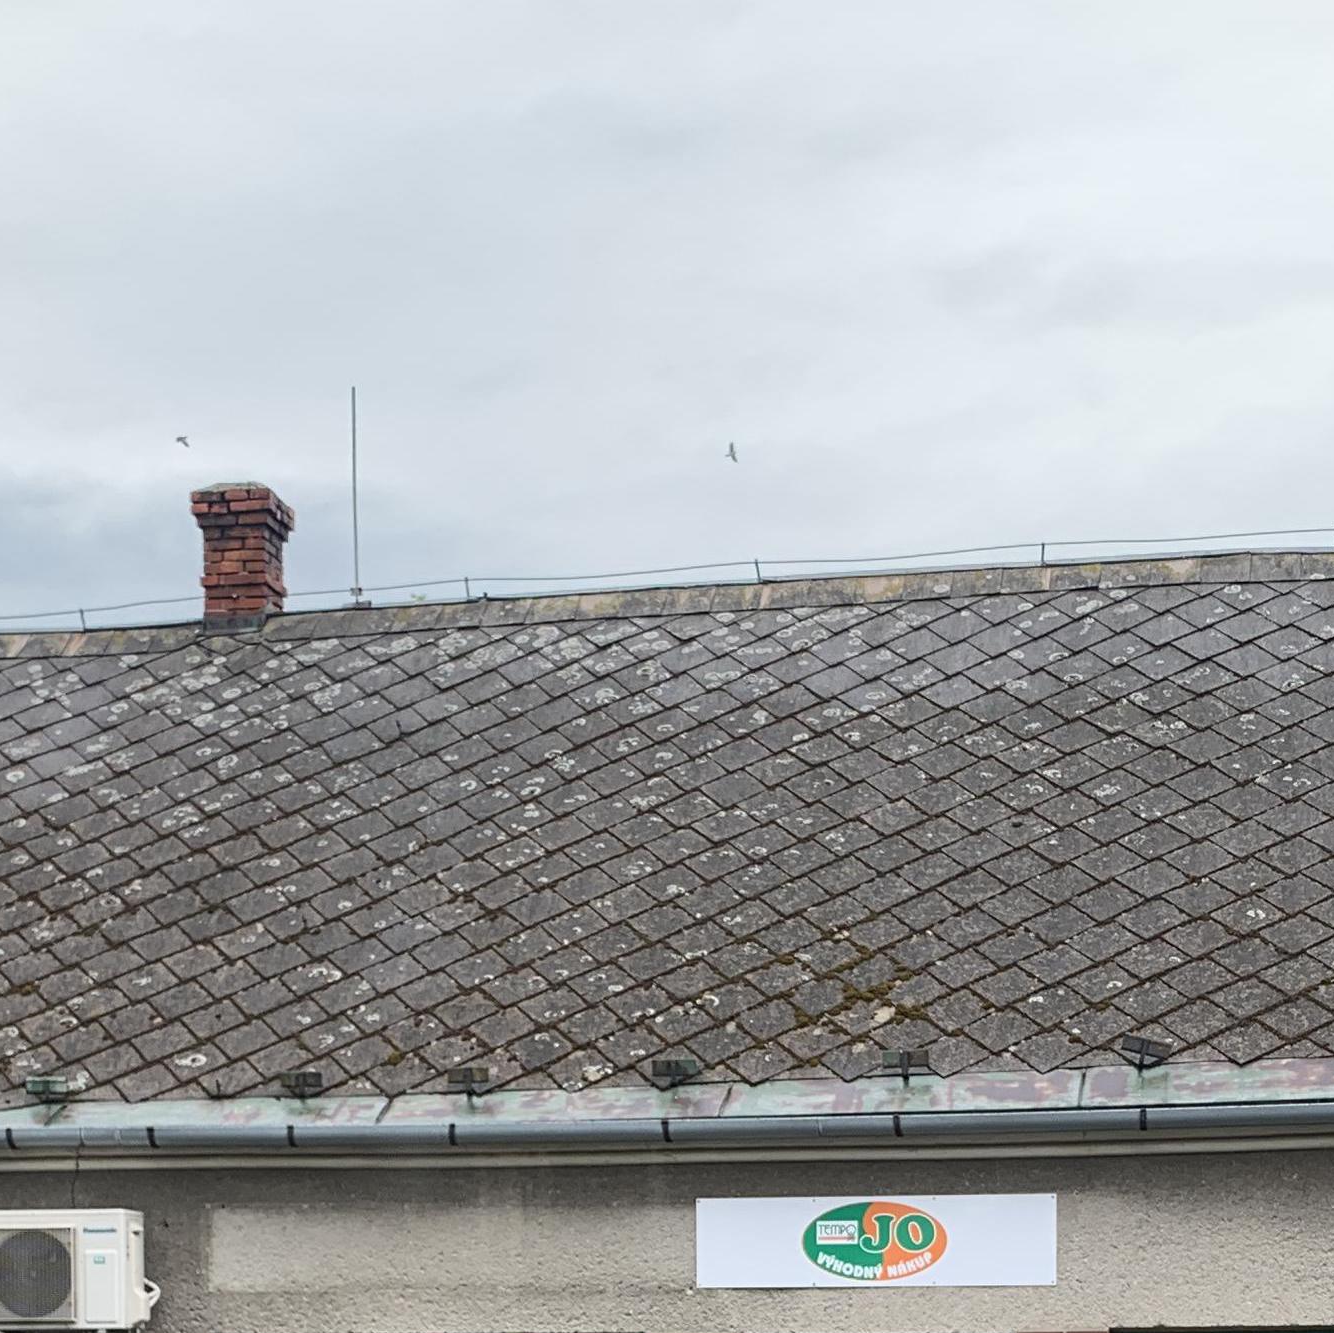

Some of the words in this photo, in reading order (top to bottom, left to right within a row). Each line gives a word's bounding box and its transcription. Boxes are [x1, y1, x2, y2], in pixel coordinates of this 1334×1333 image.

[818, 1224, 856, 1236] TEMPO
[859, 1212, 936, 1254] JO
[817, 1251, 883, 1279] VÝHODNÝ
[887, 1251, 932, 1278] NÁKUP
